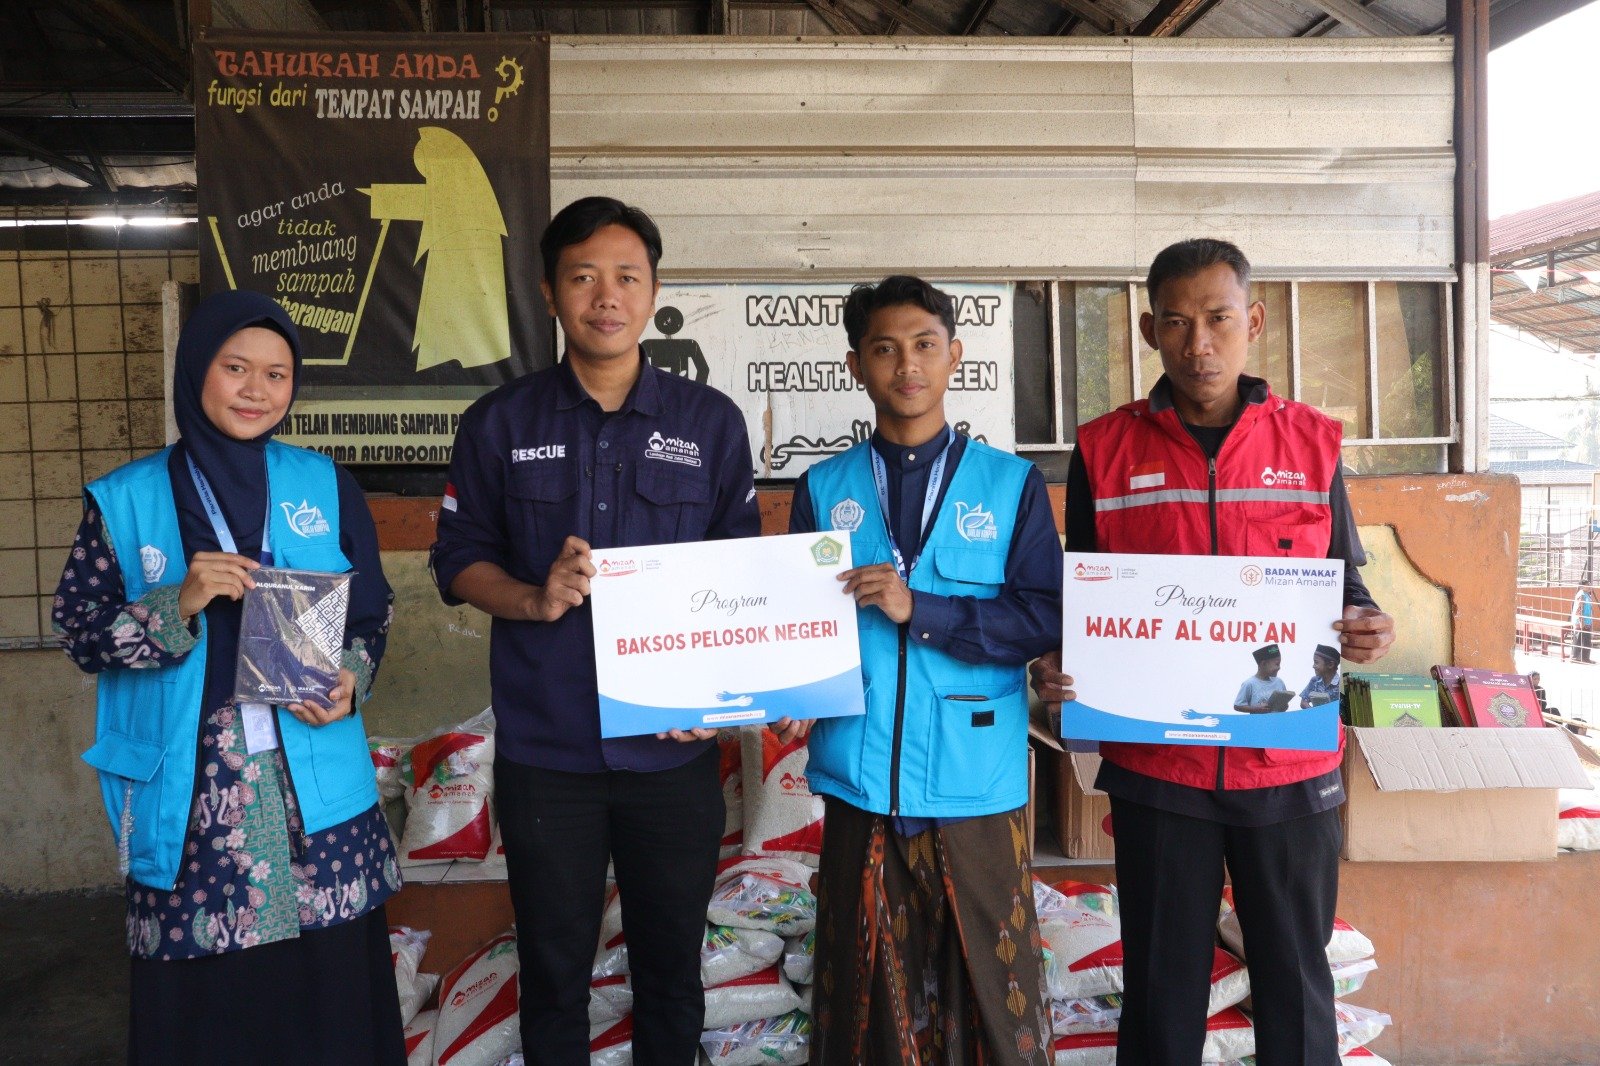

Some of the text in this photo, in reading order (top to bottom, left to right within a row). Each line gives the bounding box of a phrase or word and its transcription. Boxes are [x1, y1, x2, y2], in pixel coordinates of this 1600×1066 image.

[208, 80, 263, 114] fungsi
[270, 81, 307, 107] dari
[315, 88, 395, 119] TEMPAT
[398, 88, 482, 120] SAMPAH
[237, 180, 346, 228] agar anda
[278, 218, 337, 237] tidak
[252, 234, 358, 274] membuang
[276, 268, 356, 299] sampah
[273, 295, 355, 335] barangan
[746, 295, 851, 326] KANT
[748, 361, 998, 392] HEALTH EEN
[294, 413, 329, 435] TELAH
[331, 413, 398, 435] MEMBUANG
[400, 413, 449, 435] SAMPAH
[361, 445, 453, 462] ALFURQONIY
[511, 444, 566, 463] RESCUE
[665, 437, 700, 451] mizan
[665, 445, 700, 457] amanah
[1276, 470, 1307, 481] mizan
[1264, 567, 1338, 578] BADAN WAKAF
[1265, 576, 1337, 588] Mizan Amanah
[690, 589, 768, 617] Program
[1154, 584, 1238, 615] Program
[616, 619, 839, 656] BAKSOS PELOSOK NEGERI
[1085, 615, 1297, 644] WAKAF AL QUR'AN
